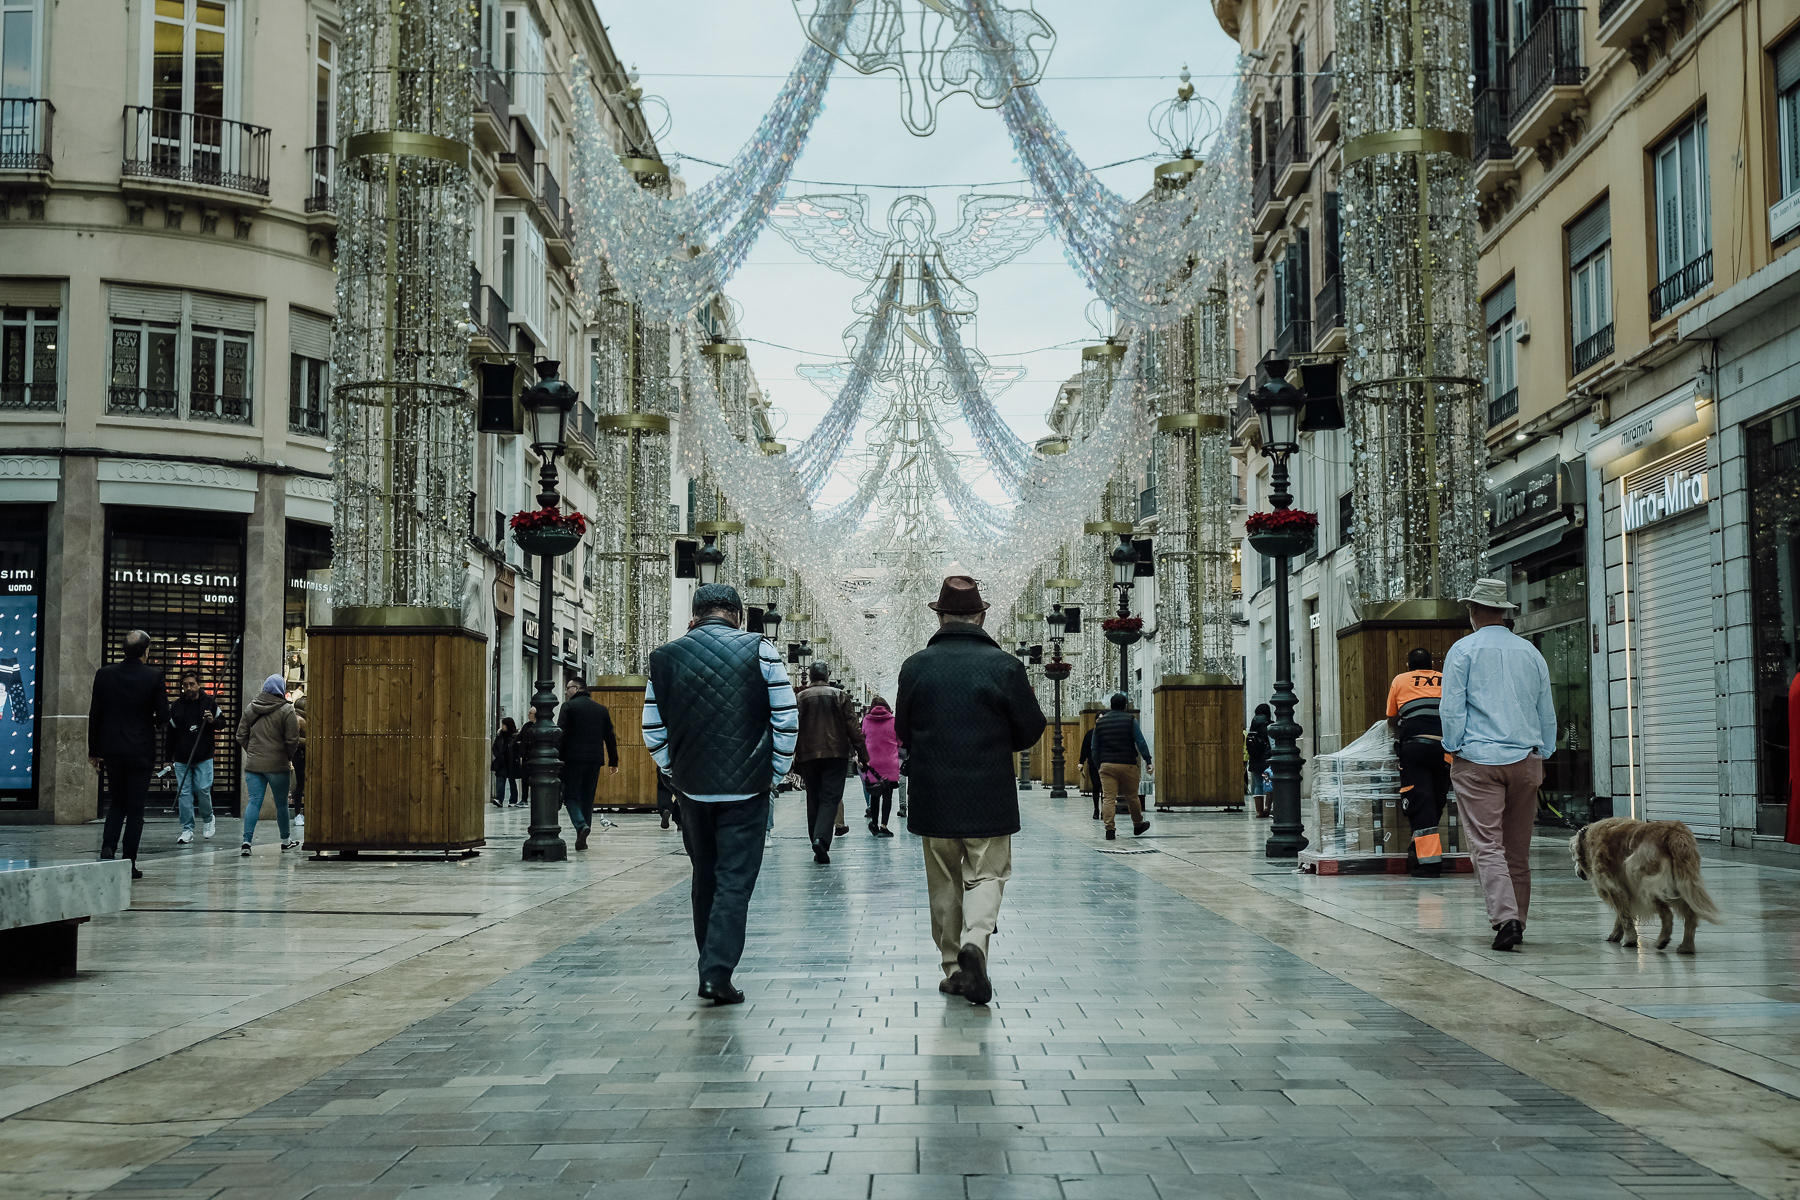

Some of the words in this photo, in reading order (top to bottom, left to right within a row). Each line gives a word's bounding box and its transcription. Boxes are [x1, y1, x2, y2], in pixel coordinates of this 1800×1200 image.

[36, 333, 56, 342] ASV
[115, 337, 137, 347] ASV
[225, 348, 245, 358] ASV
[34, 360, 56, 369] ASV
[114, 358, 137, 366] GRUPO
[115, 364, 137, 373] ASV
[225, 374, 244, 384] ASV
[1621, 419, 1653, 446] miramira
[1622, 471, 1705, 532] Mira-Mira
[115, 569, 237, 587] intimissimi
[8, 584, 32, 592] uomo
[204, 594, 234, 603] uomo
